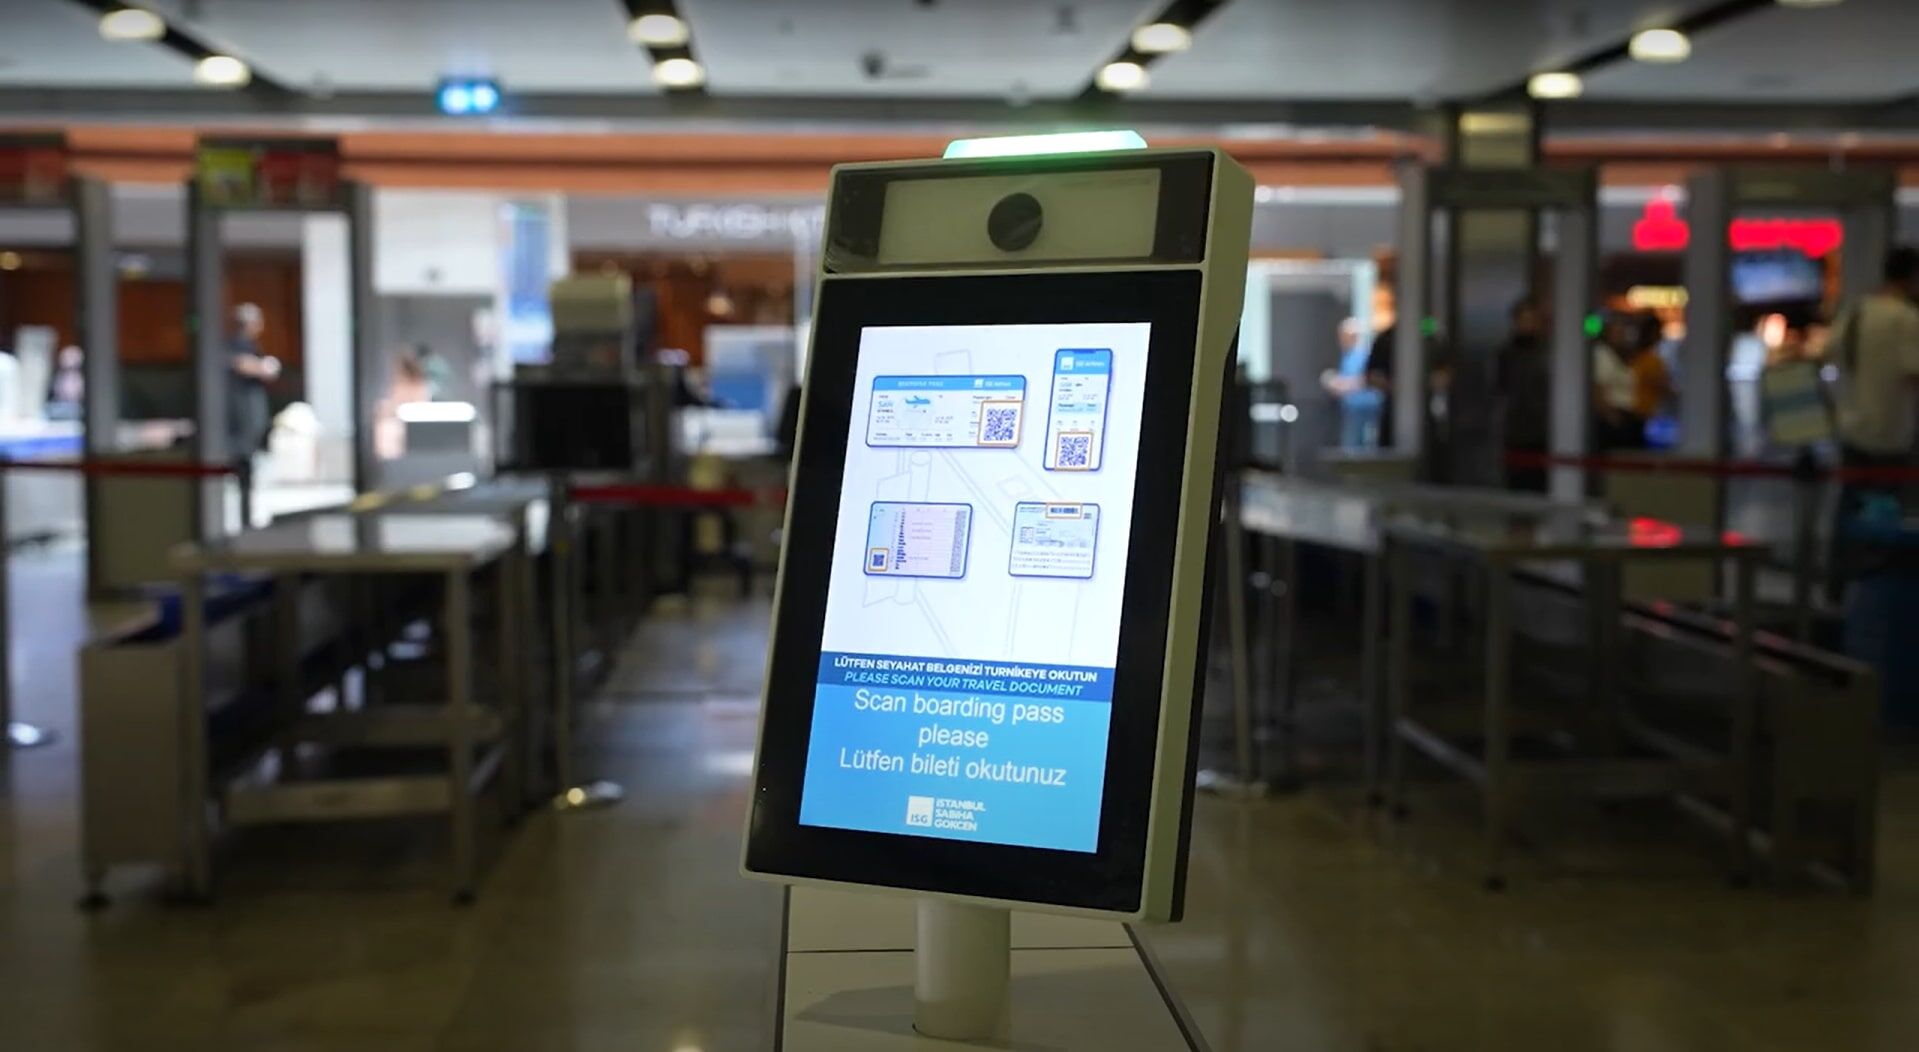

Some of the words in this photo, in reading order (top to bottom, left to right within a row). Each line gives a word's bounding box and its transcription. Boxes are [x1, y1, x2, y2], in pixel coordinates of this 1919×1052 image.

[834, 655, 875, 669] LÜTFEN
[875, 660, 925, 672] SEYAHAT
[926, 662, 983, 675] BELGENİZİ
[984, 665, 1047, 680] TURNİKEYE
[1048, 669, 1097, 682] OKUTUN
[844, 671, 889, 684] PLEASE
[890, 674, 925, 687] SCAN
[926, 676, 961, 689] YOUR
[961, 678, 1008, 691] TRAVEL
[1009, 681, 1083, 696] DOCUMENT
[854, 688, 906, 712] Scan
[913, 693, 1006, 724] boarding
[1011, 703, 1065, 725] pass
[918, 723, 989, 748] please
[839, 747, 904, 773] Lütfen
[911, 752, 961, 777] bileti
[965, 758, 1067, 786] okutunuz
[910, 812, 929, 824] ISG
